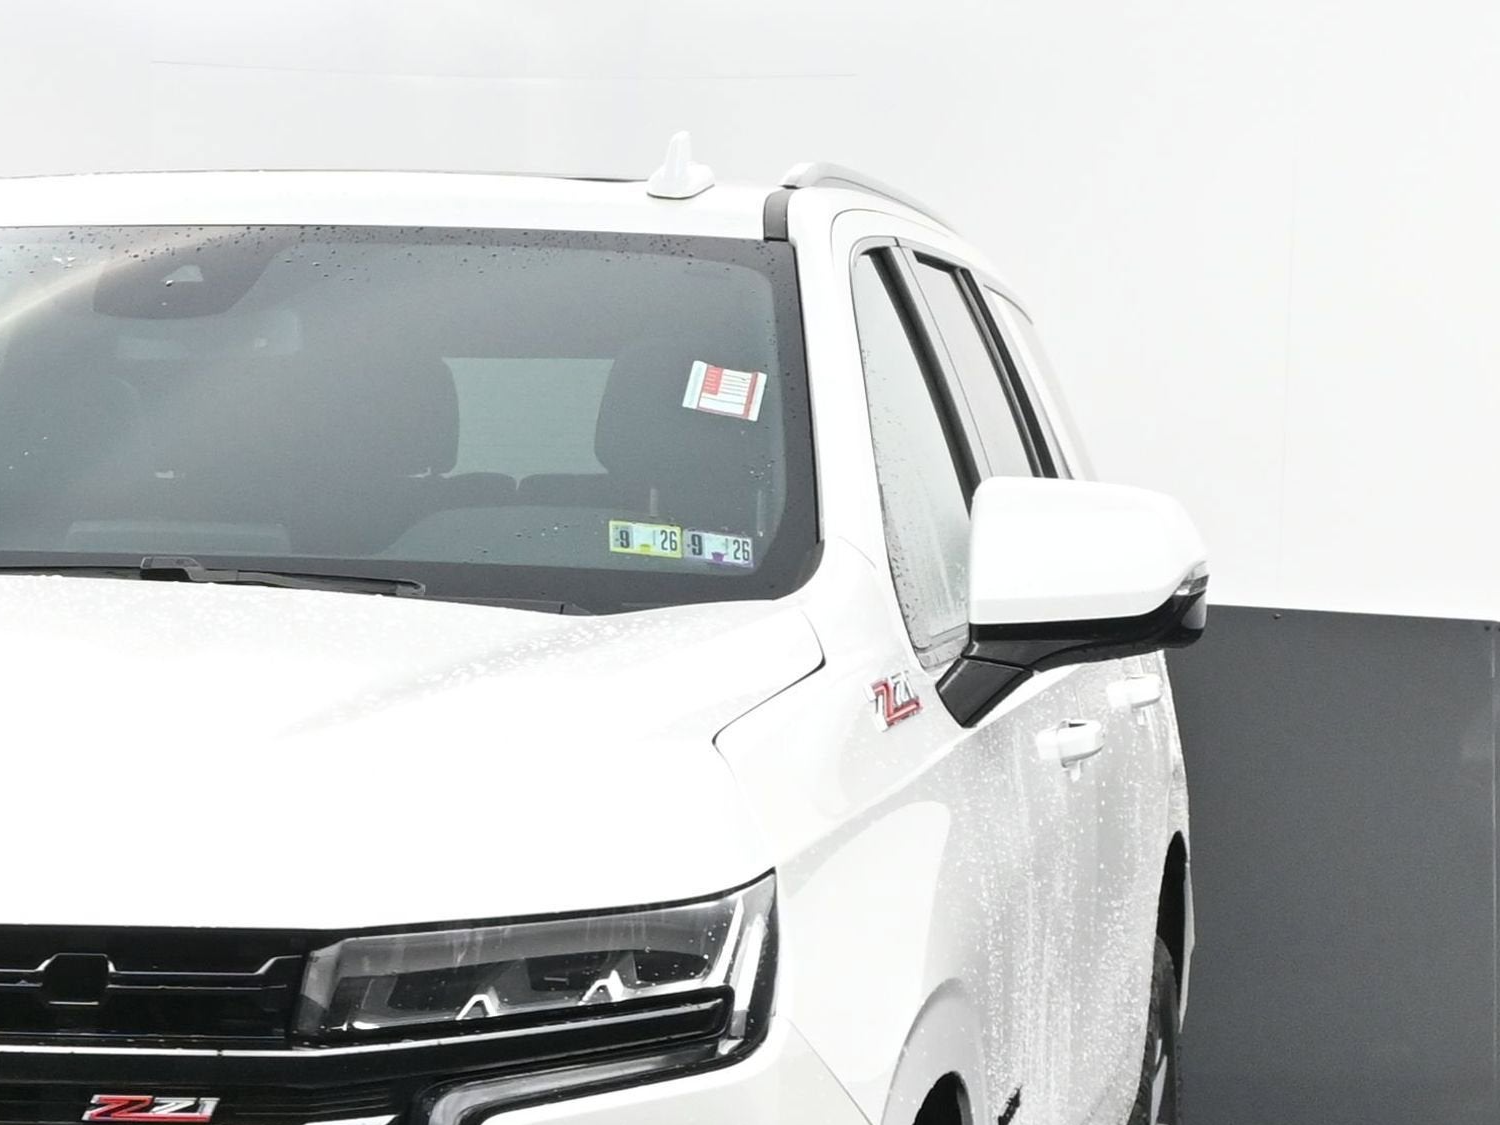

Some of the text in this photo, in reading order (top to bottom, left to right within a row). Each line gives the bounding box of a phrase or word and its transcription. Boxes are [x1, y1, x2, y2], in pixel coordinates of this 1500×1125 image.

[619, 529, 678, 551] 9 26
[691, 533, 751, 561] 9 26
[82, 1094, 220, 1123] Z71
